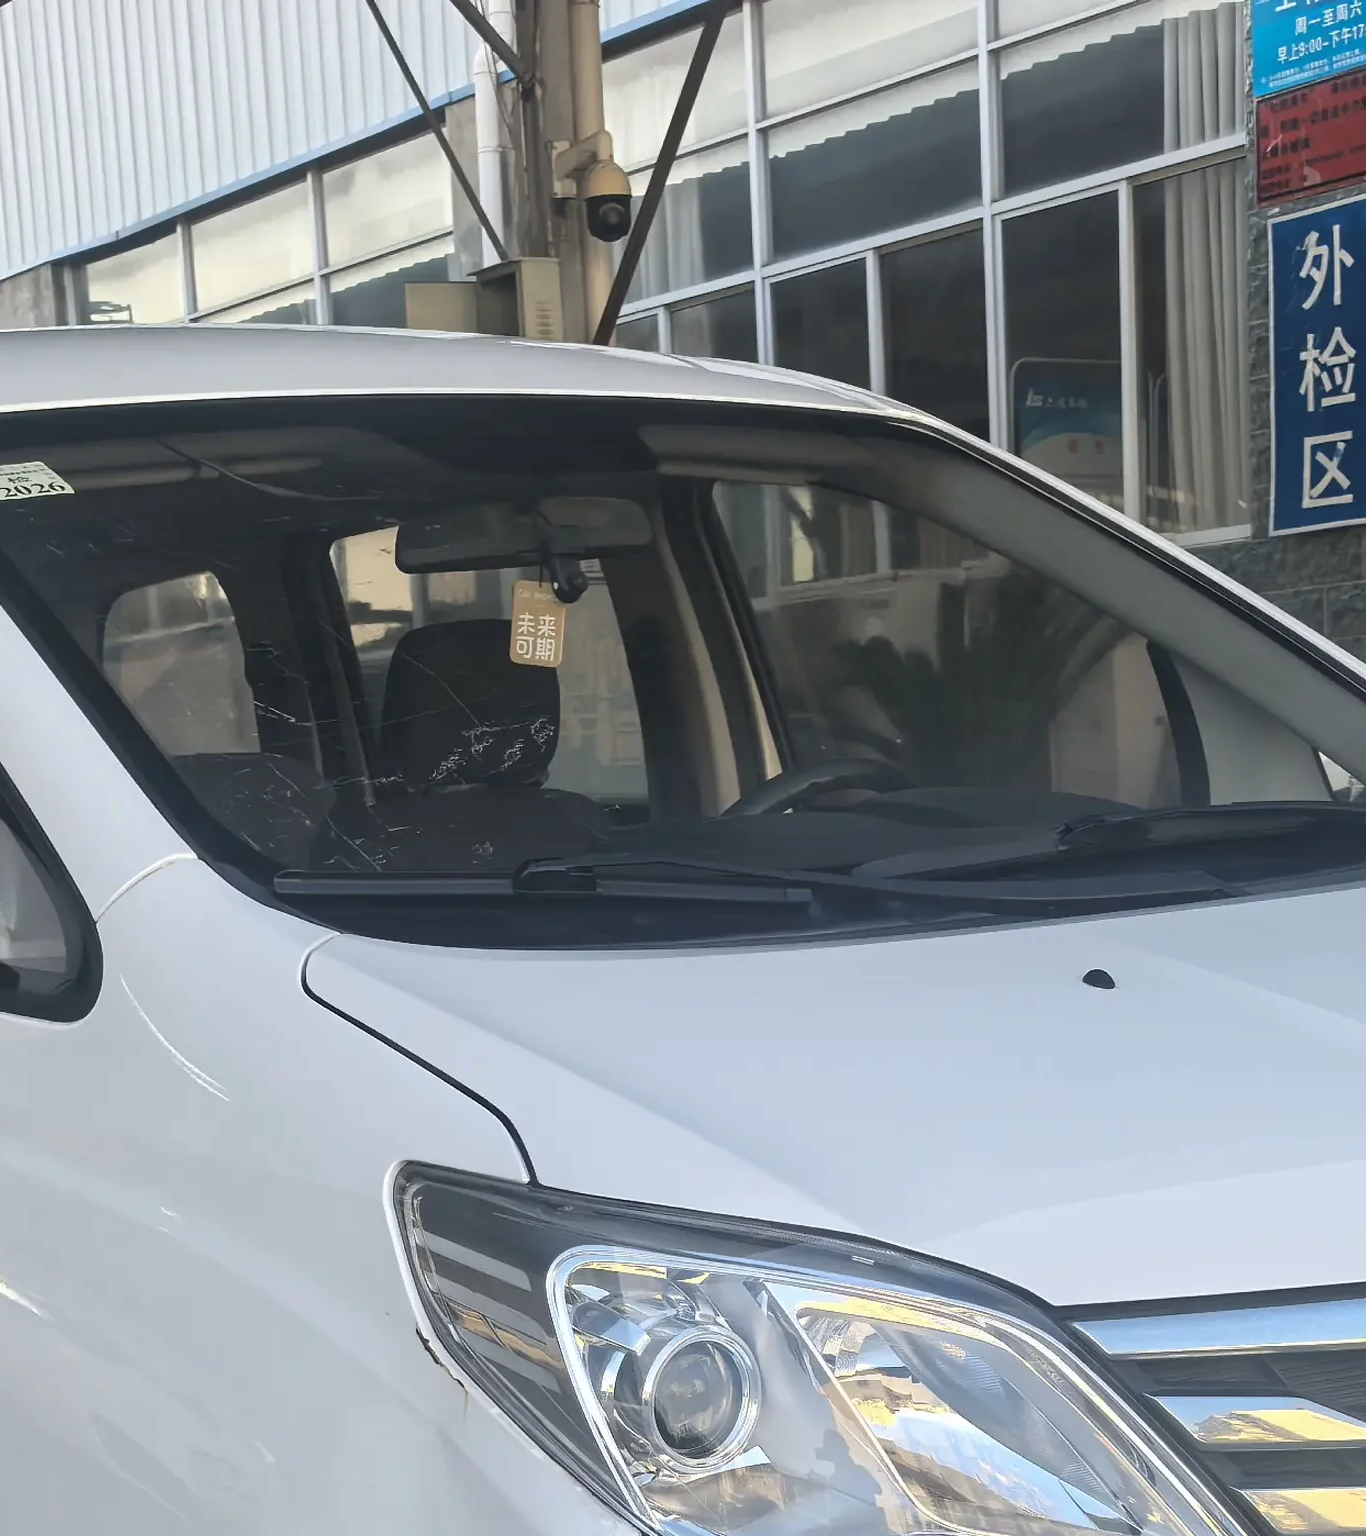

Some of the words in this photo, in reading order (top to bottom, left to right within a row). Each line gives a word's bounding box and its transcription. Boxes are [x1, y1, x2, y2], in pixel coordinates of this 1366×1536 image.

[1295, 2, 1362, 36] 周一至周六
[1299, 224, 1357, 509] 外检区
[517, 612, 556, 637] 未来
[516, 635, 556, 662] 可期
